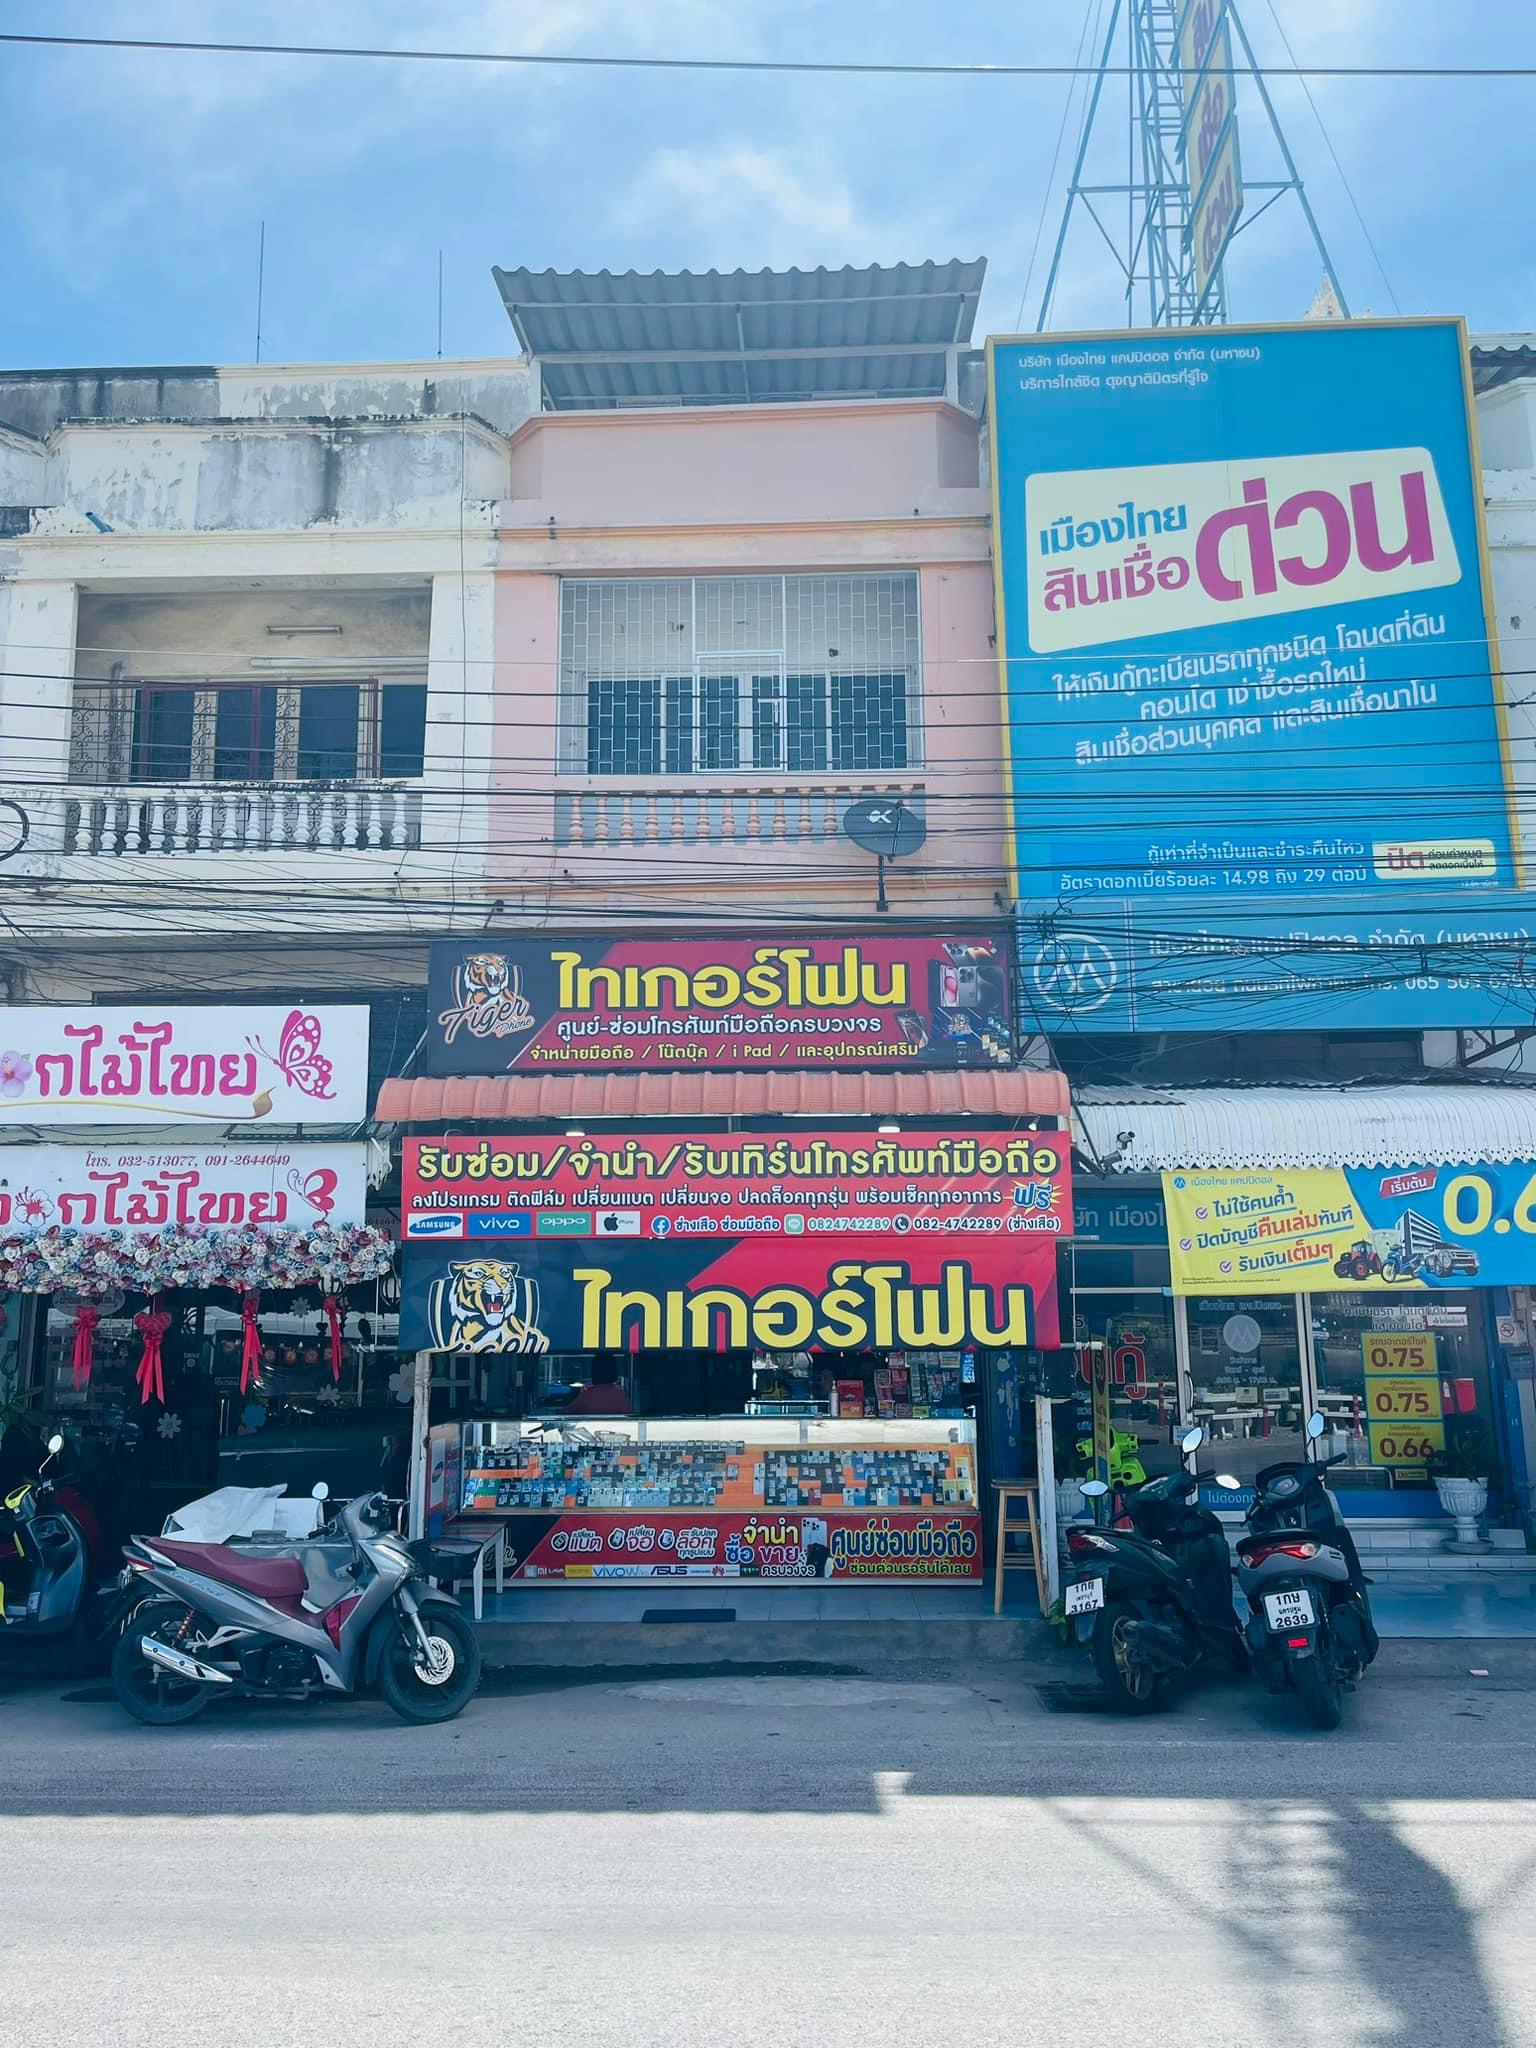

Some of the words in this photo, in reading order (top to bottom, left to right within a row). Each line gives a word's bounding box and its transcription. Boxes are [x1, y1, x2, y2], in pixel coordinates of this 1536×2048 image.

[1018, 355, 1051, 368] บริษัท
[1057, 352, 1106, 366] เมืองไทย
[1111, 350, 1169, 364] แคปปิตอล
[1174, 348, 1205, 362] จำกัด
[1210, 346, 1261, 362] (มหาชน)
[1020, 373, 1100, 390] บริการใกล้ชิด
[1040, 502, 1188, 556] เมืองไทย
[1195, 471, 1435, 602] ด่วน
[1043, 543, 1190, 612] สินเชื่อ
[1052, 634, 1327, 702] ให้เงินกู้ทะเบียนรถทุกชนิด
[1336, 609, 1446, 653] โฉนดที่ดิน
[1140, 683, 1217, 721] คอนโด
[1075, 715, 1262, 767] สินเชื่อส่วนบุคคล
[1273, 680, 1438, 731] และสินเชื่อนาโน
[1148, 838, 1365, 866] กู้เท่าที่จำเป็นและชำระคืนไหว
[1060, 869, 1217, 891] อัตราดอกเบี้ยร้อยละ
[1223, 870, 1270, 886] 14.98
[1303, 868, 1326, 883] 29
[551, 947, 906, 1009] ไทเกอร์โฟน
[439, 997, 530, 1043] Tiger
[557, 1014, 881, 1042] ศูนย์-ซ่อมโทรศัพท์มือถือครบวงจร
[530, 1043, 634, 1061] จำหน่ายมือถือ
[744, 1043, 772, 1058] Pad
[796, 1040, 919, 1062] และอุปกรณ์เสริม
[117, 1156, 199, 1168] 032-513077,
[205, 1154, 291, 1167] 091-2644649
[412, 1190, 500, 1208] ลงโปรแกรม
[507, 1188, 566, 1207] ติดฟิล์ม
[572, 1185, 654, 1206] เปลี่ยนแบต
[661, 1184, 731, 1206] เปลี่ยนจอ
[738, 1185, 849, 1209] ปลดล็อคทุกรุ่น
[855, 1184, 1002, 1209] พร้อมเช็คทุกอาการ
[1014, 1182, 1053, 1209] ฟรี
[1213, 1184, 1295, 1217] ไม่ใช้คนค้ำ
[415, 1220, 456, 1230] SAMSUNG
[480, 1217, 520, 1230] vivo
[674, 1217, 718, 1232] ช่างเสือ
[721, 1215, 780, 1231] ซ่อมมือถือ
[807, 1218, 890, 1231] 0824742289
[914, 1217, 1002, 1231] 082-4742289
[1007, 1216, 1061, 1232] (ช่างเสือ)
[1197, 1204, 1353, 1250] ปิดบัญชีคืนเล่มทันที
[1239, 1239, 1334, 1273] รับเงินเต็มๆ
[573, 1264, 1030, 1349] ไทเกอร์โฟน
[1371, 1347, 1424, 1368] 0.75
[1375, 1392, 1430, 1413] 0.75
[1379, 1437, 1434, 1458] 0.66
[743, 1516, 799, 1545] จำนำ
[627, 1537, 653, 1551] จอ
[724, 1533, 754, 1563] ซื้อ
[758, 1546, 800, 1563] ขาย
[831, 1518, 977, 1570] ศูนย์ซ่อมมือถือ
[650, 1565, 688, 1576] ASUS
[761, 1564, 816, 1577] ครบวงจร
[1071, 1599, 1098, 1613] 3167
[1275, 1613, 1309, 1628] 2639
